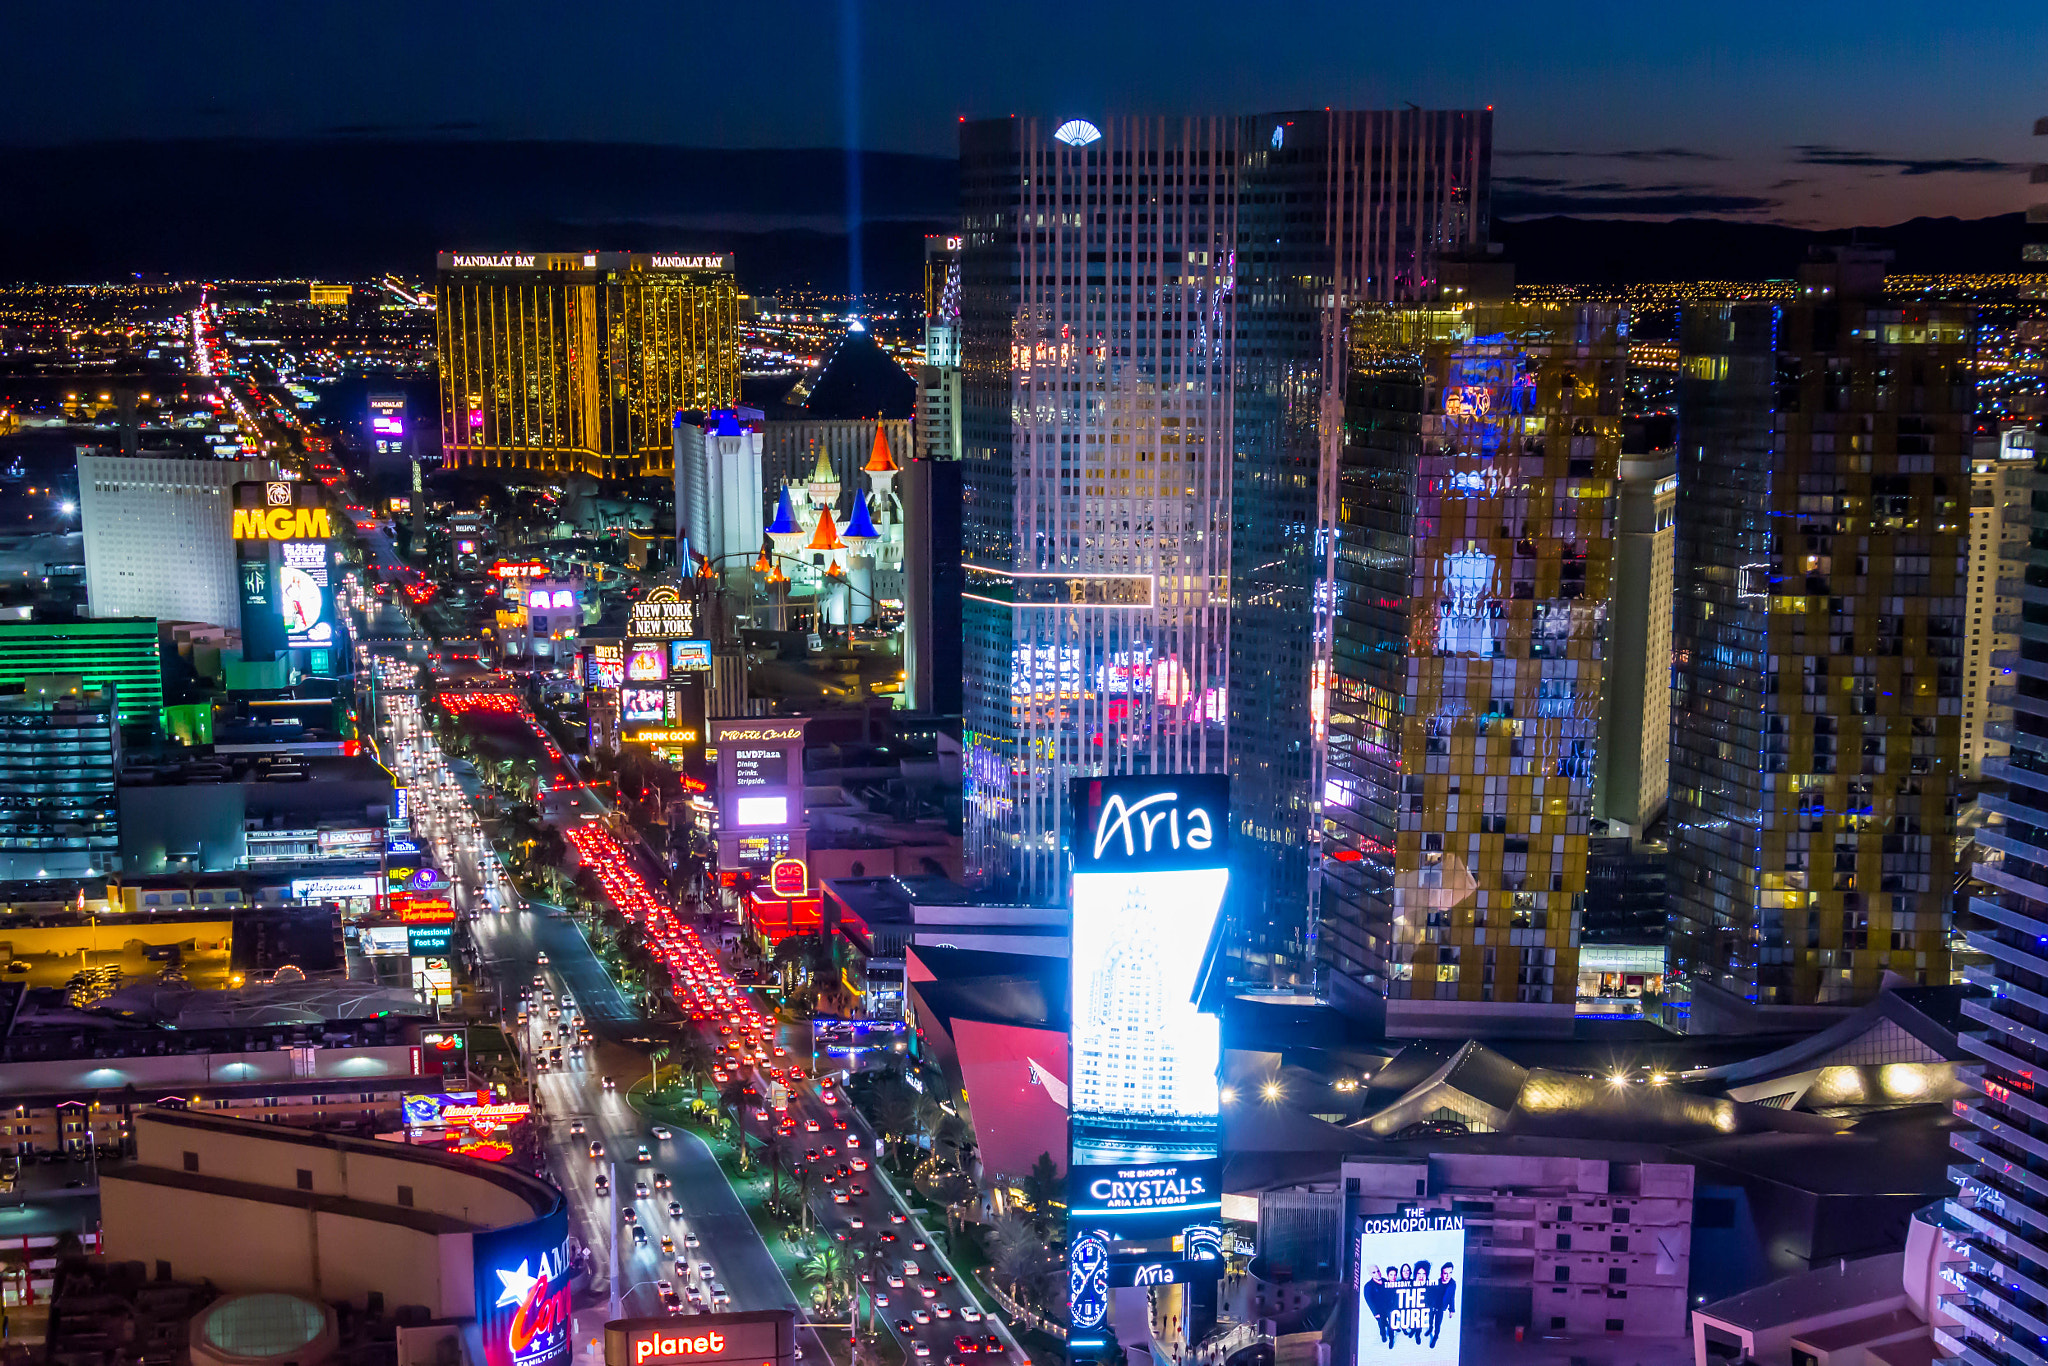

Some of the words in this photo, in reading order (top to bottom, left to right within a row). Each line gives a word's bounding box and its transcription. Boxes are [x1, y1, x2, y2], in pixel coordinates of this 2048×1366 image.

[454, 256, 514, 267] MANDALAY
[515, 256, 535, 267] BAY
[652, 256, 704, 268] MANDALAY
[706, 256, 722, 268] BAY
[232, 508, 330, 540] MGM
[635, 604, 659, 618] NEW
[662, 604, 692, 617] YORK
[636, 620, 659, 633] NEW
[662, 620, 693, 633] YORK
[667, 691, 676, 718] SHAKE
[720, 730, 761, 741] Monte
[762, 729, 801, 740] Carlo
[1094, 792, 1212, 859] Aria
[777, 866, 801, 876] CVS
[305, 883, 363, 894] Walgreens
[409, 928, 450, 936] Professional
[432, 939, 445, 947] Spa
[1118, 1170, 1140, 1178] THE
[1142, 1169, 1165, 1178] SHOPS
[1166, 1168, 1177, 1176] AT
[1107, 1199, 1131, 1207] ARIA
[1133, 1198, 1152, 1206] LAS
[1155, 1196, 1186, 1204] VEGAS
[1404, 1208, 1425, 1217] THE
[1365, 1216, 1463, 1234] COSMOPOLITAN
[1135, 1264, 1174, 1286] Aria
[1396, 1288, 1426, 1308] THE
[1390, 1308, 1430, 1329] CURE
[636, 1331, 724, 1364] planet
[517, 1356, 546, 1366] FAMILY
